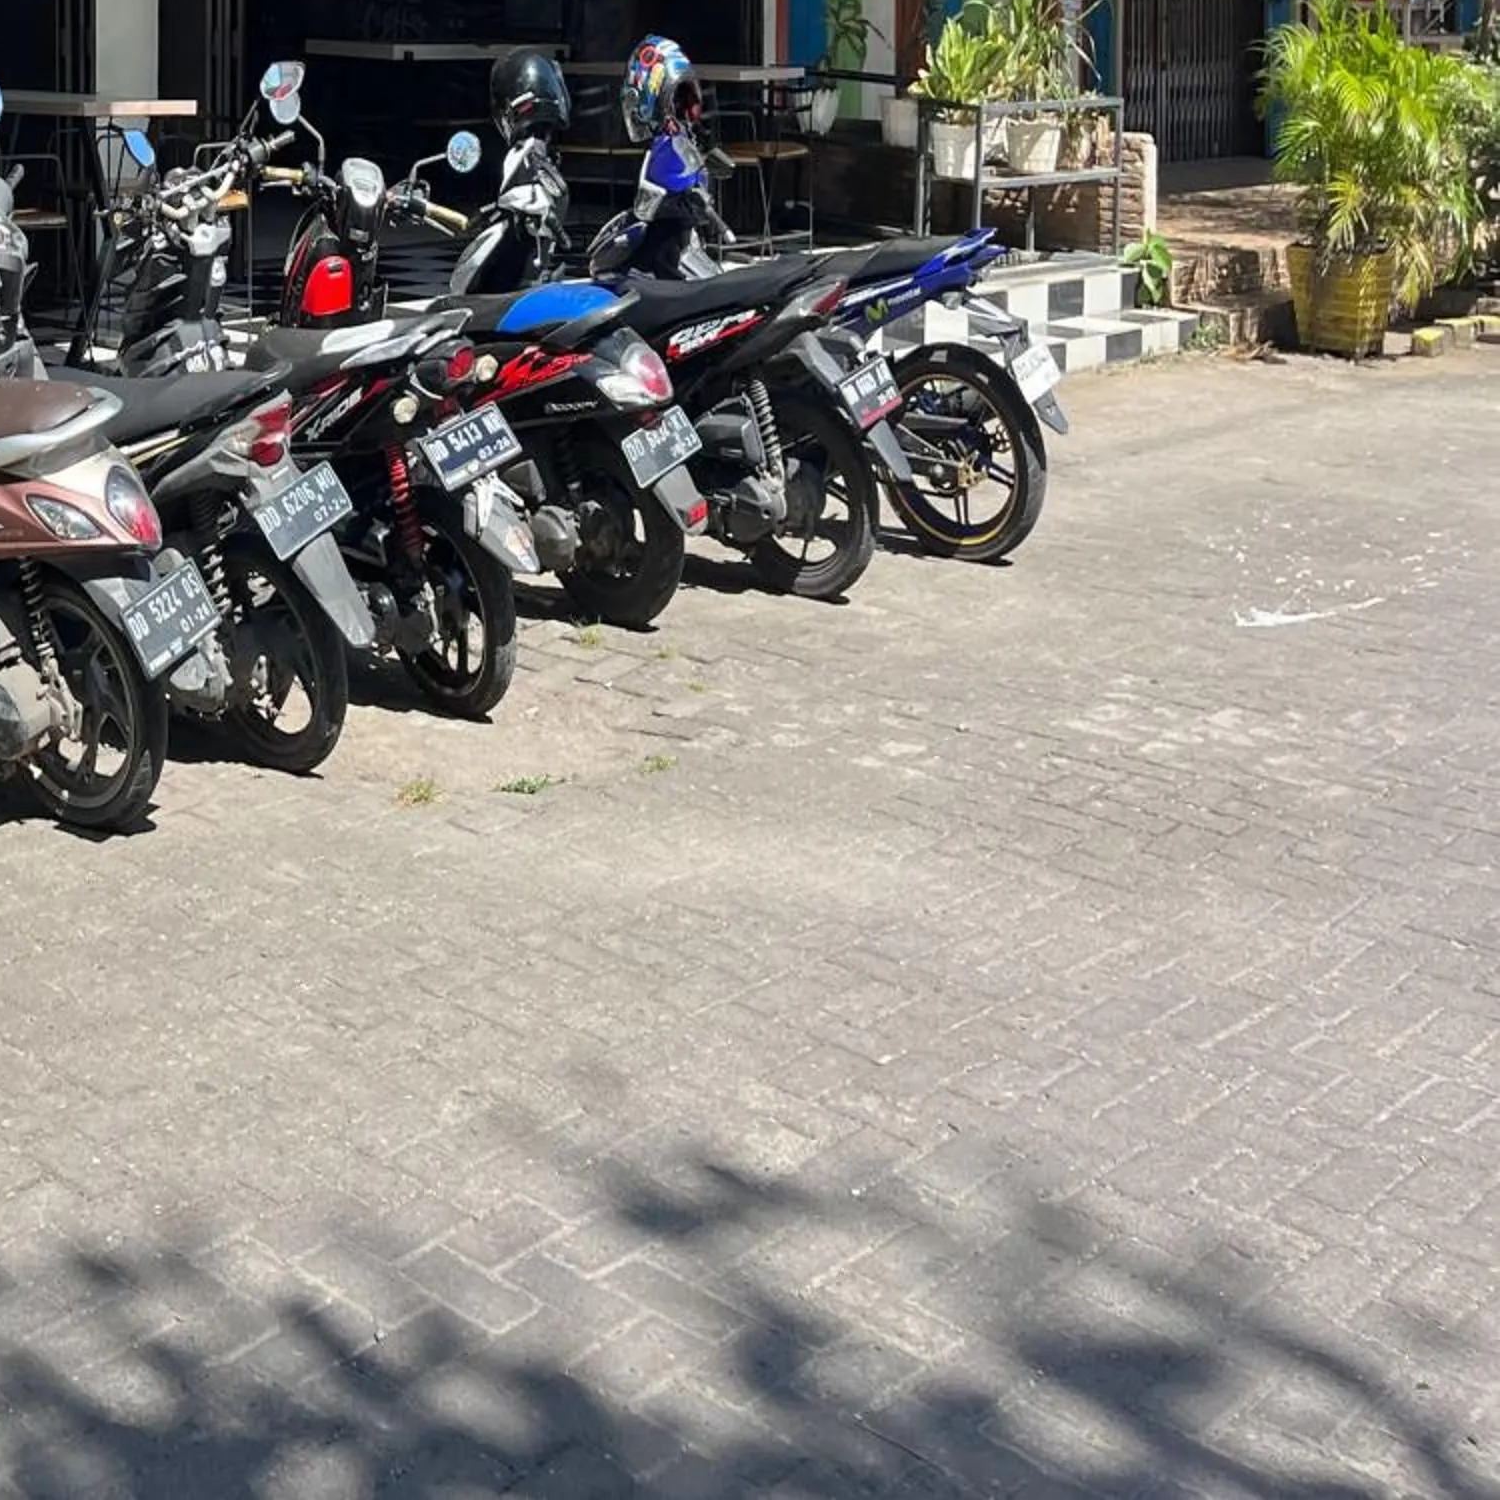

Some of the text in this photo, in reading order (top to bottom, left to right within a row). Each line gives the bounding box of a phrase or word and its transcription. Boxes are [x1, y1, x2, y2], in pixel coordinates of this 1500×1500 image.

[447, 421, 483, 453] 5413
[259, 505, 282, 534] DD
[281, 481, 316, 517] 6206
[128, 611, 151, 642] DD
[147, 586, 183, 625] 5224
